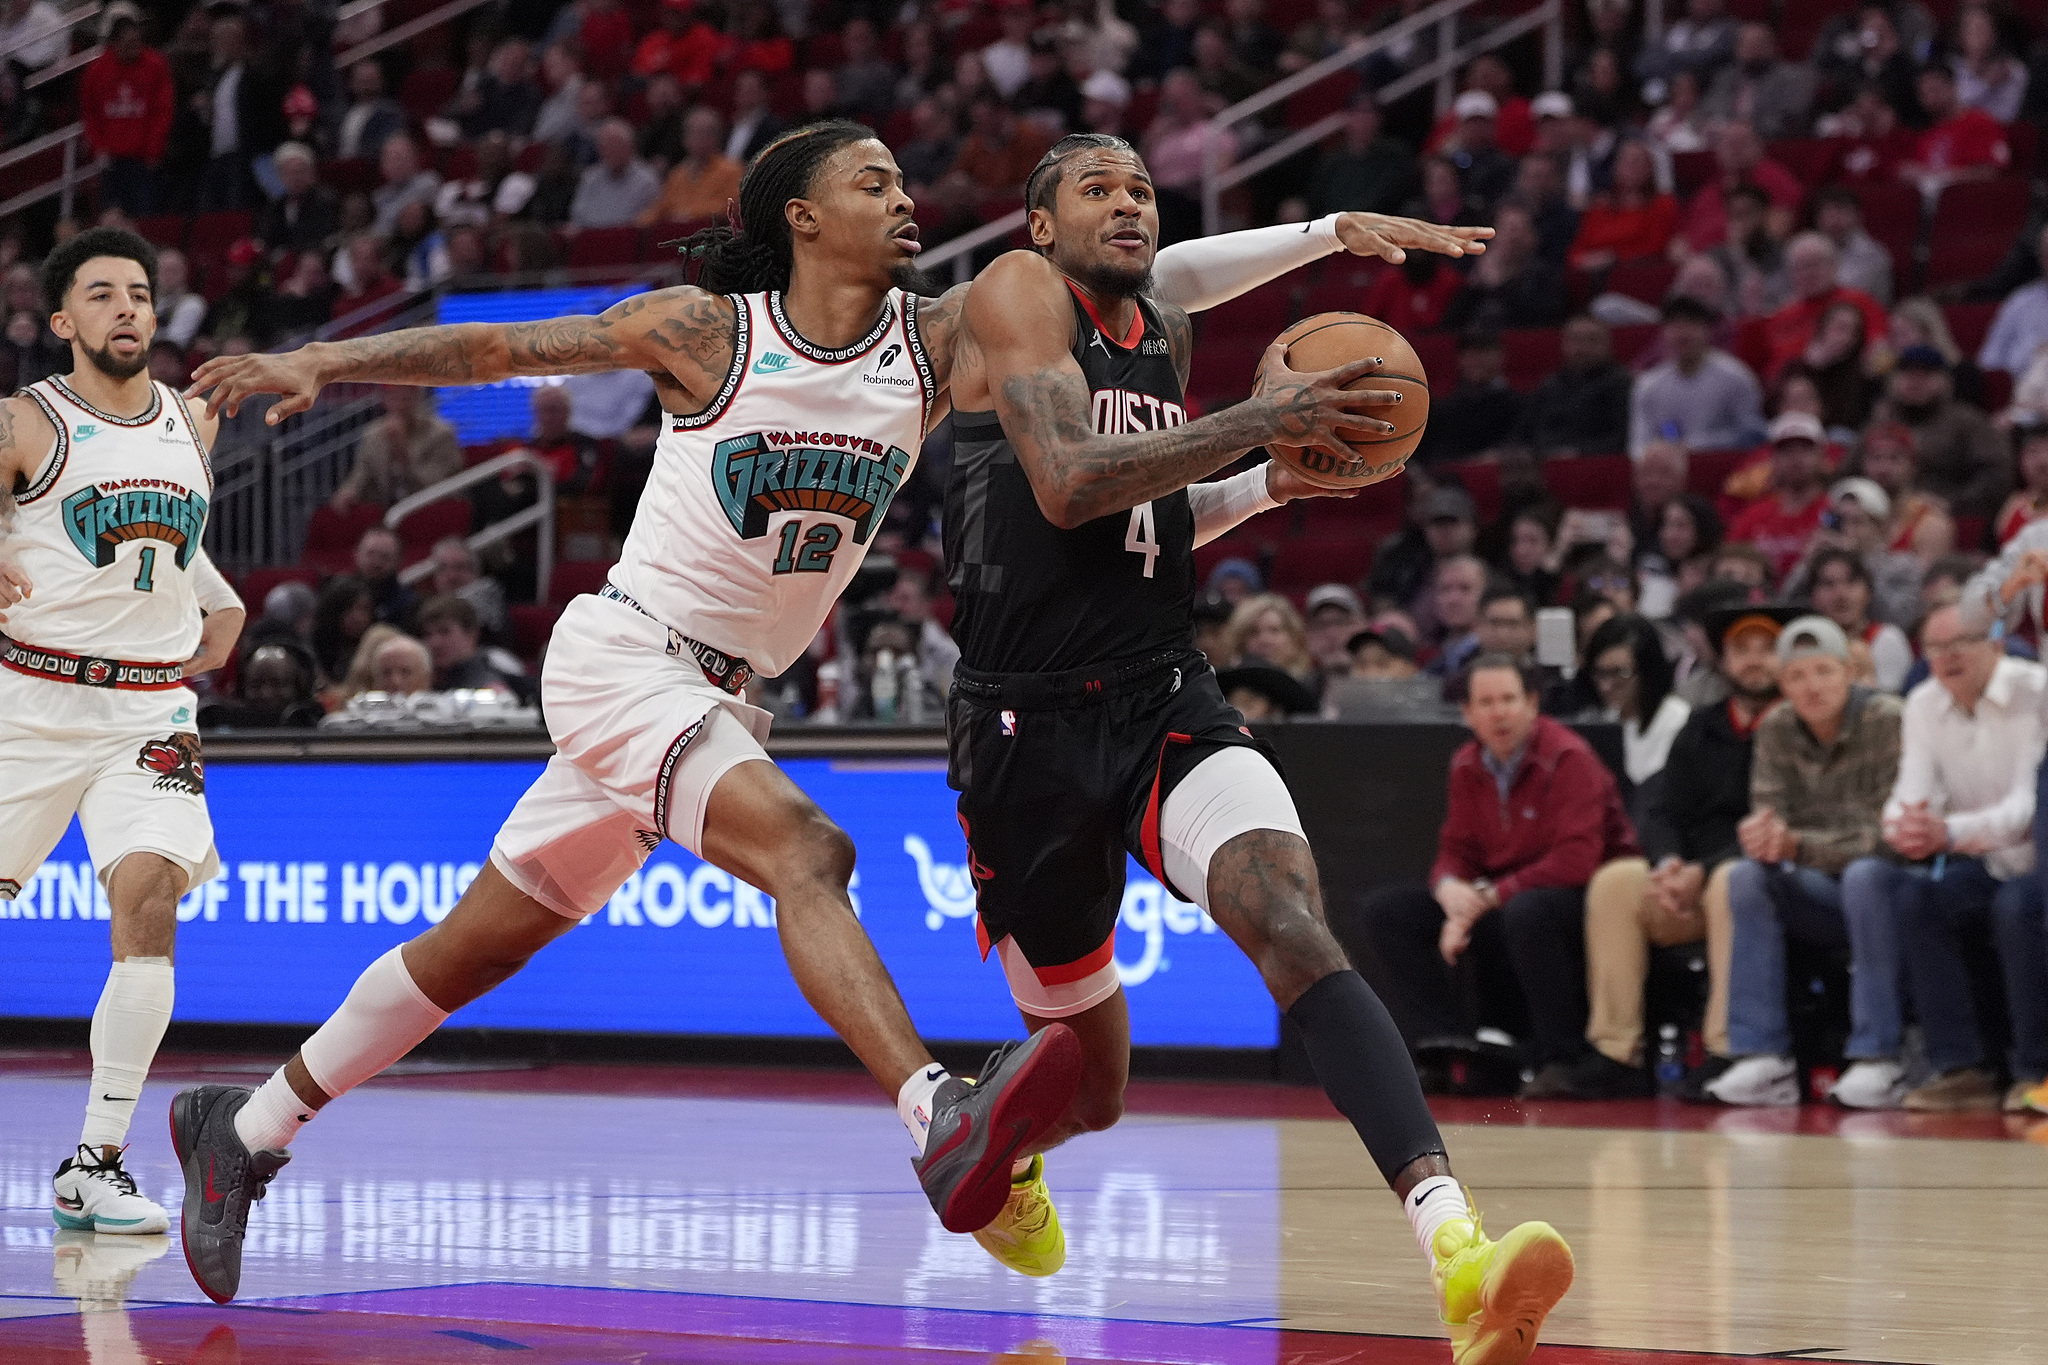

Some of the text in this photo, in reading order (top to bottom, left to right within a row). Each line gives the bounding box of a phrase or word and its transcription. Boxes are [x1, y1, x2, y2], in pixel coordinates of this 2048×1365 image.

[760, 351, 792, 369] NIKE
[1142, 338, 1168, 348] MEMO
[1142, 346, 1169, 355] HERM
[863, 374, 914, 387] Robinhood
[1091, 389, 1188, 435] OUSTO
[767, 431, 883, 456] VANCOUVER
[99, 479, 187, 497] VANCOUVER
[711, 432, 910, 545] GRIZZLIES
[61, 485, 209, 572] GRIZZLIES
[772, 520, 843, 576] 12
[1125, 500, 1160, 579] 4
[134, 546, 157, 593] 1
[238, 862, 328, 923] THE
